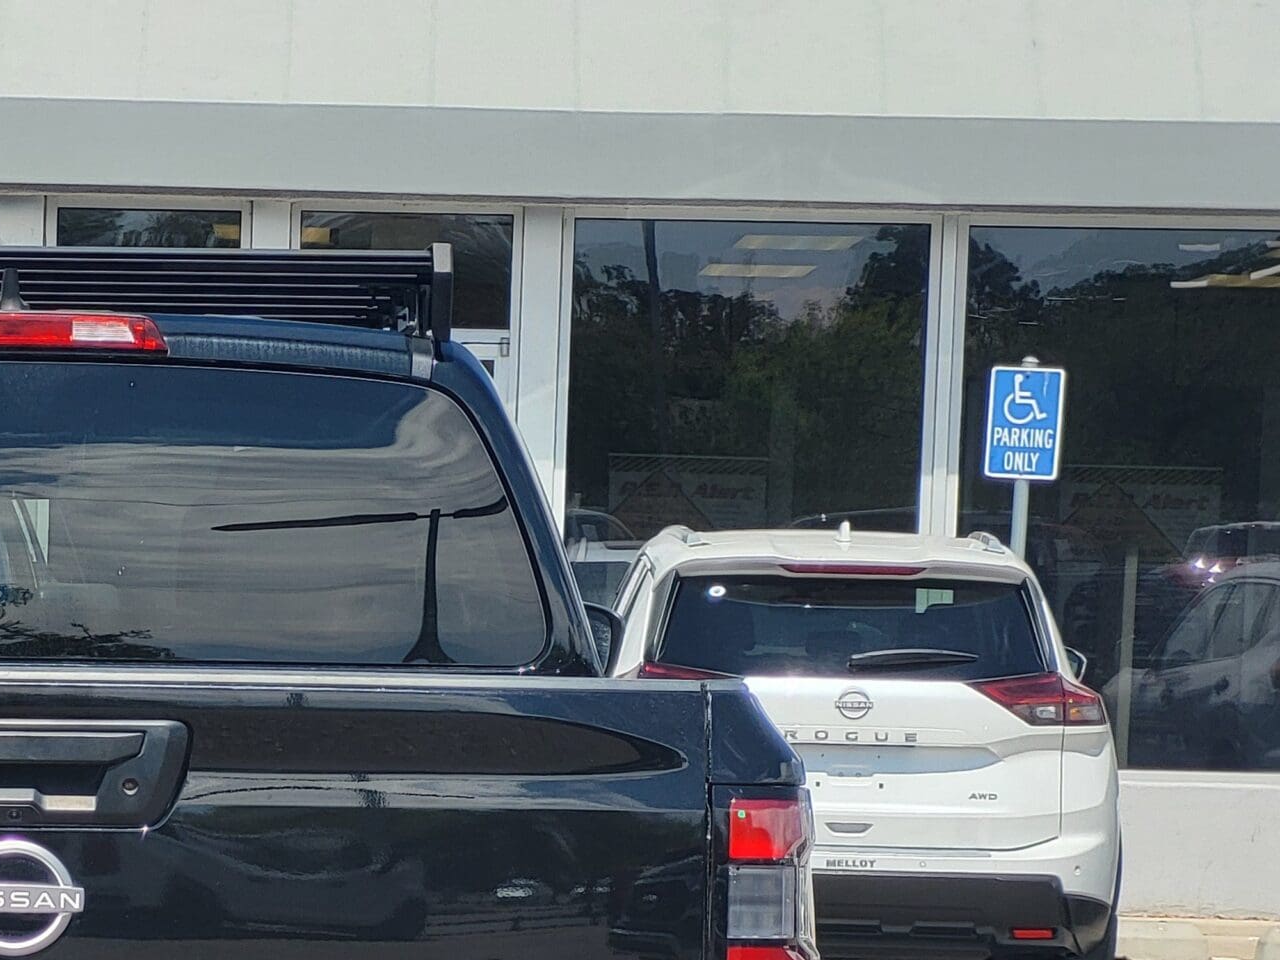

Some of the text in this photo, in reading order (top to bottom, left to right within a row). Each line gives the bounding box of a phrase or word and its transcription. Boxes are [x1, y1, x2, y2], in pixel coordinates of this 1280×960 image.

[993, 427, 1054, 449] PARKING
[1004, 451, 1039, 472] ONLY
[835, 701, 873, 709] NISSAN
[784, 730, 918, 743] ROGUE
[826, 859, 877, 868] MELLOY
